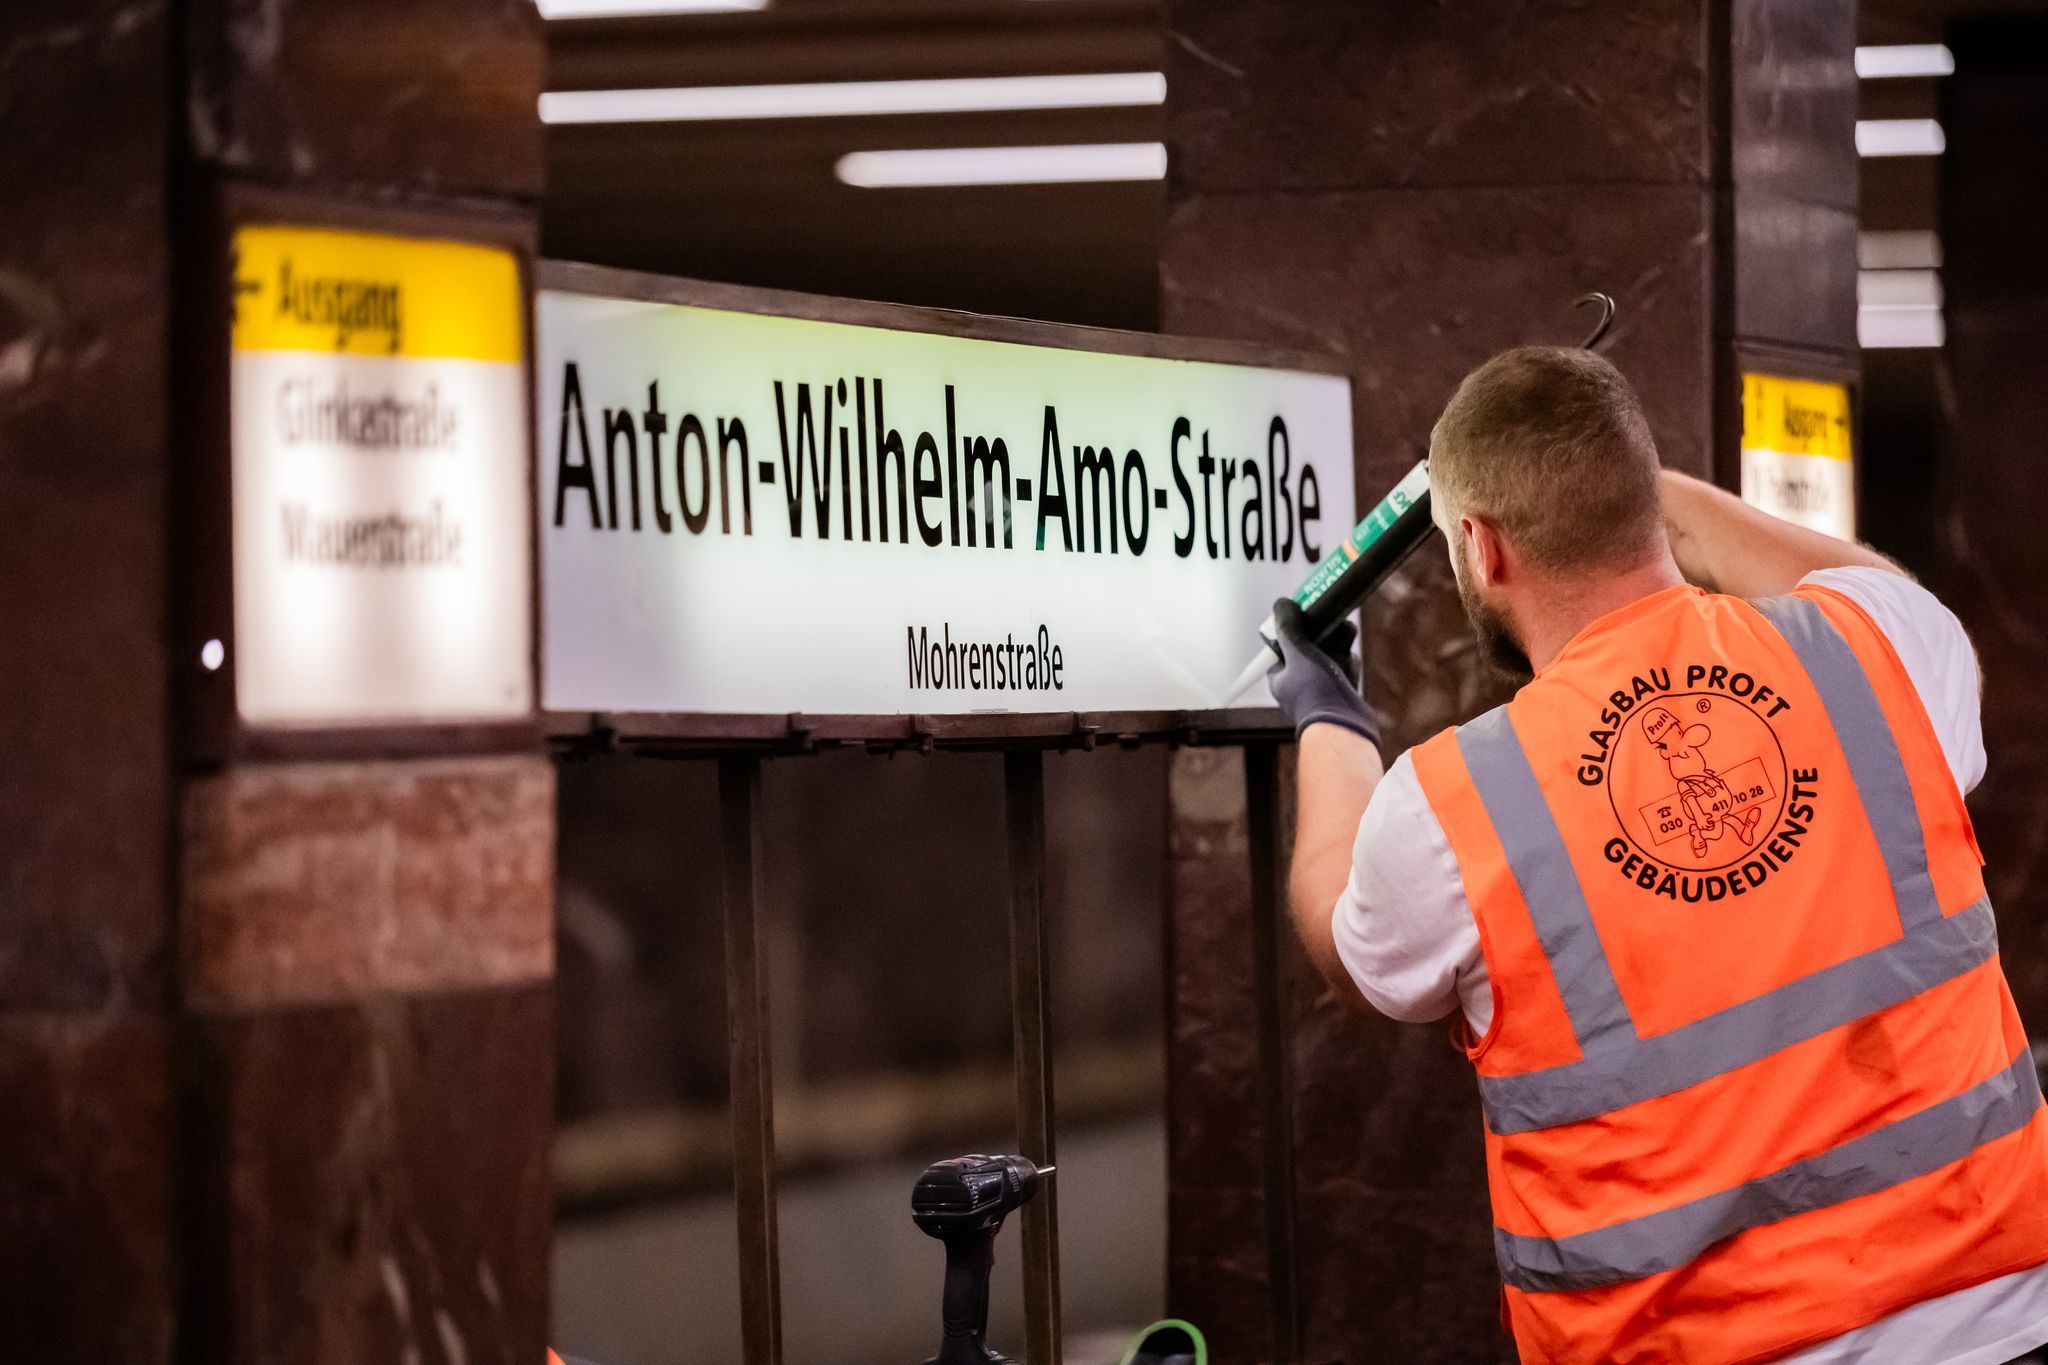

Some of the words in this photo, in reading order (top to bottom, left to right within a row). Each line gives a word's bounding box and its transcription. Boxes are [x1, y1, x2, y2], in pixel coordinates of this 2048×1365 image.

[275, 256, 404, 352] Ausgang
[553, 361, 1320, 564] Anton-Wilhelm-Amo-Straße
[907, 622, 1064, 690] Mohrenstraße
[1577, 667, 1671, 786] GLASBAU
[1687, 665, 1791, 718] PROFT
[1647, 712, 1669, 735] Proft
[1603, 767, 1818, 903] GEBÄUDEDIENSTE
[1659, 817, 1683, 834] 030
[1711, 799, 1729, 813] 411
[1733, 791, 1748, 805] 10
[1749, 784, 1765, 799] 28
